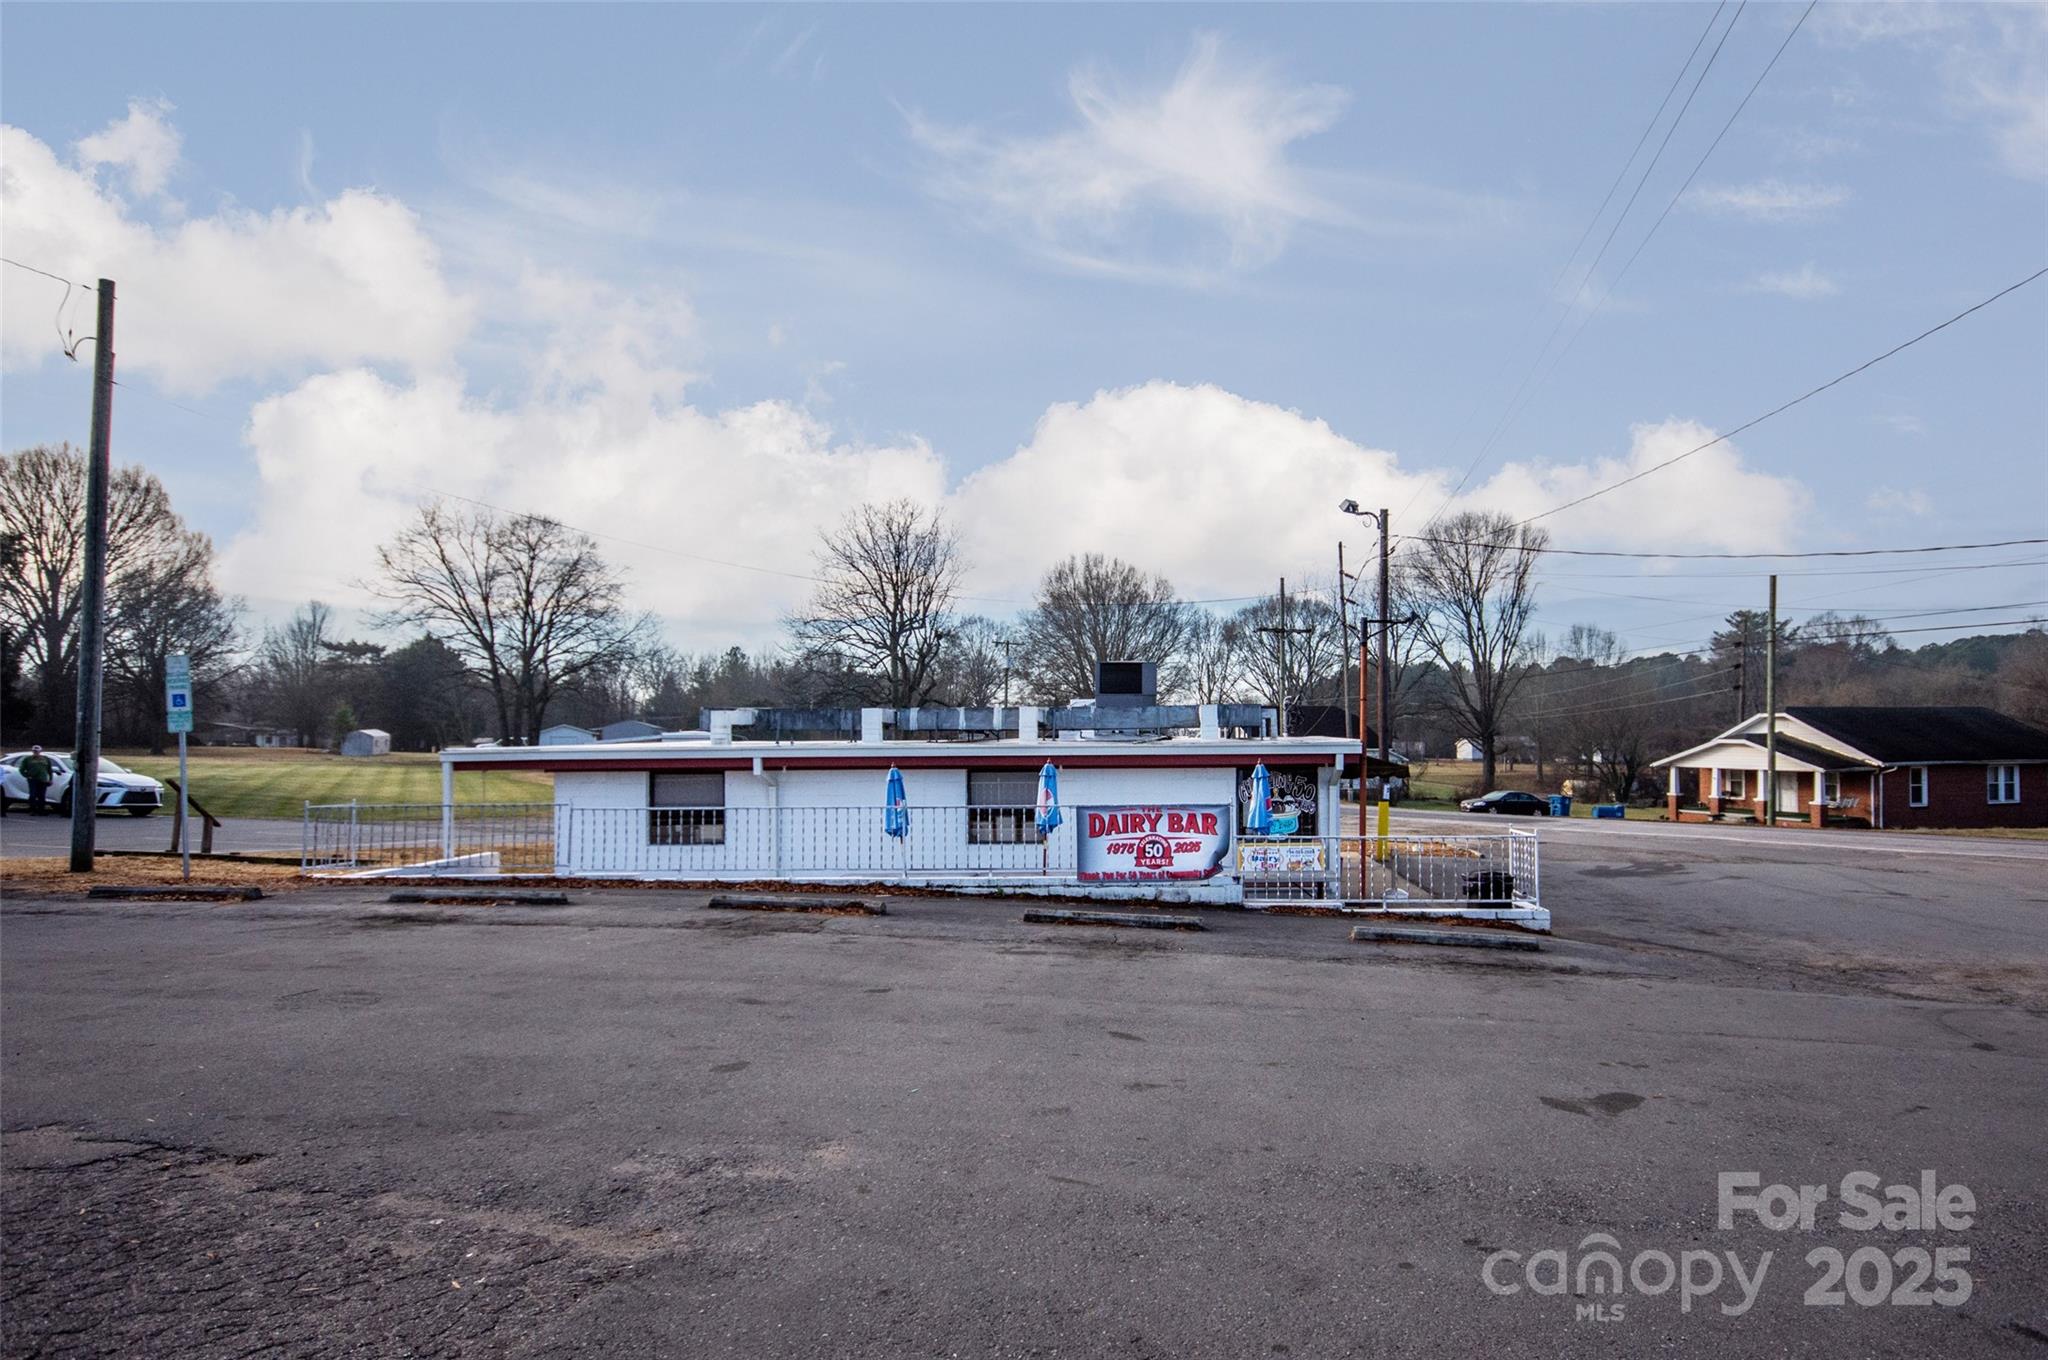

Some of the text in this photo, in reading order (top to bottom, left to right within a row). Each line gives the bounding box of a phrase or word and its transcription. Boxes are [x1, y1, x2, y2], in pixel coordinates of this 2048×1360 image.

[1087, 812, 1219, 838] DAIRY BAR
[1106, 841, 1202, 857] 1975 50 2025
[1139, 858, 1169, 866] YEARS!
